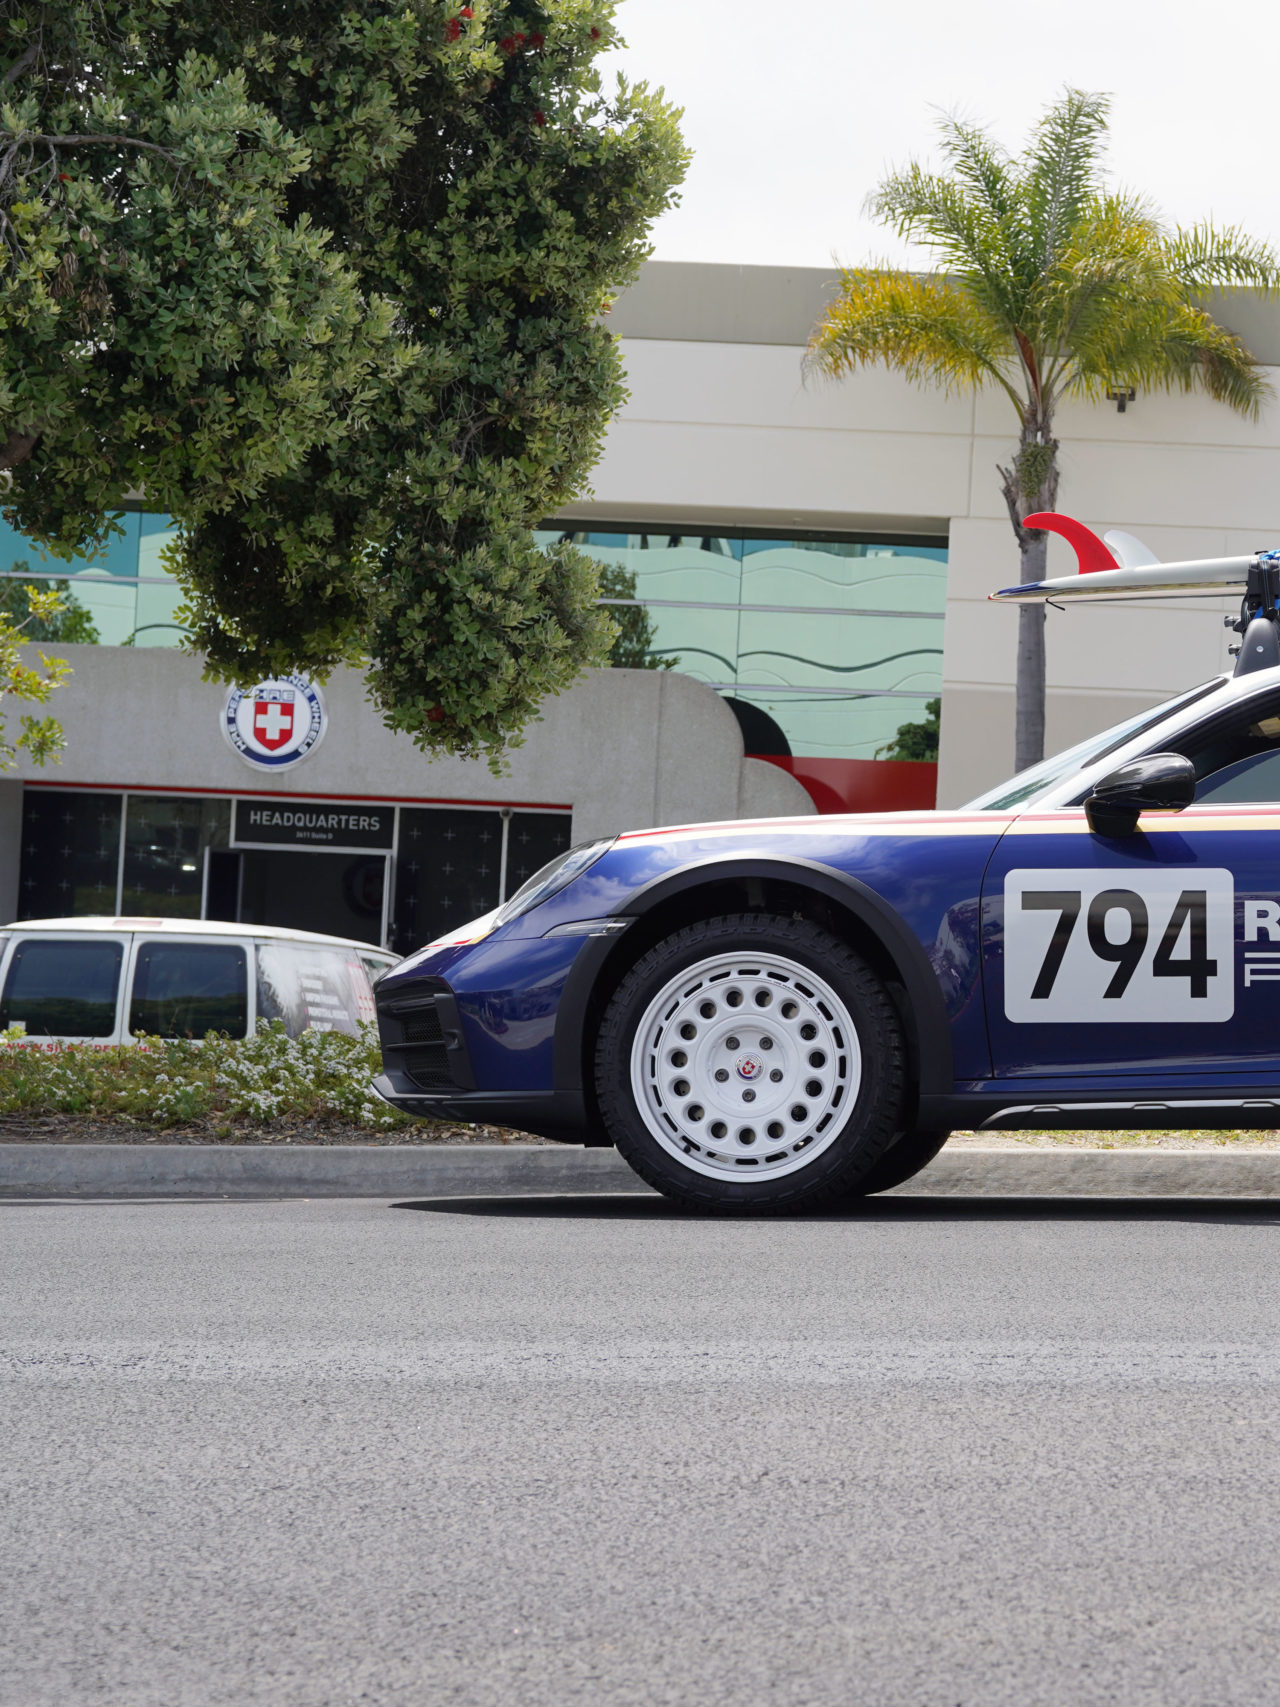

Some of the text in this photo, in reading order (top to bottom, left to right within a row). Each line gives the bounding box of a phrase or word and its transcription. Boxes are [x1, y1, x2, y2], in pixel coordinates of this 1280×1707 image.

[227, 723, 248, 752] HRE
[298, 700, 321, 755] WHEELS
[249, 810, 380, 831] HEADQUARTERS
[1021, 888, 1218, 999] 794
